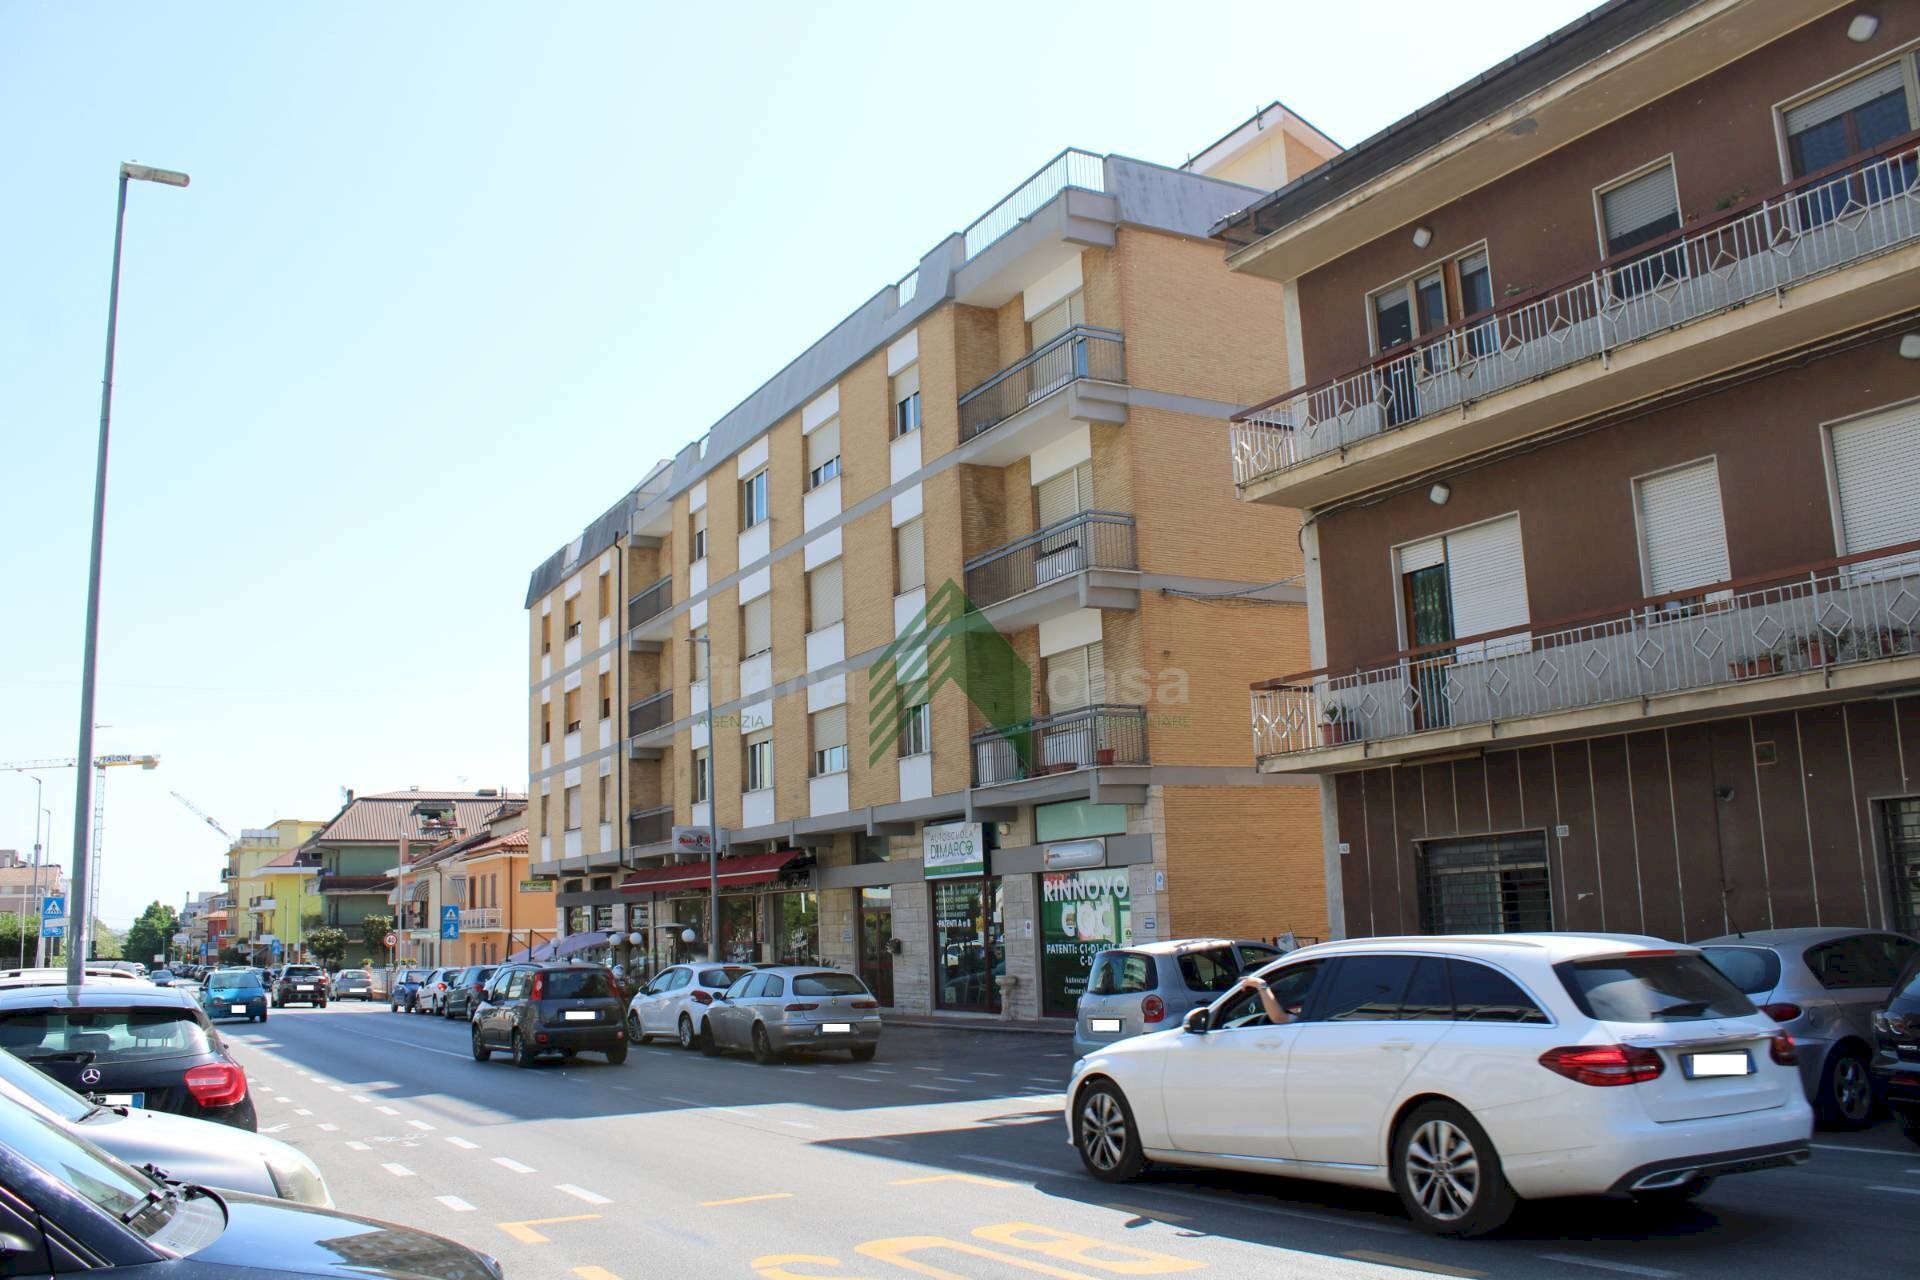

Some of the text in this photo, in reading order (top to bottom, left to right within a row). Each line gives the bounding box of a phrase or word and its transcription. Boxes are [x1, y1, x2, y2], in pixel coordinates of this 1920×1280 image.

[930, 830, 975, 844] AUTOSCUOLA
[1043, 875, 1129, 903] RINNOVO
[1046, 943, 1078, 955] PATENTI:
